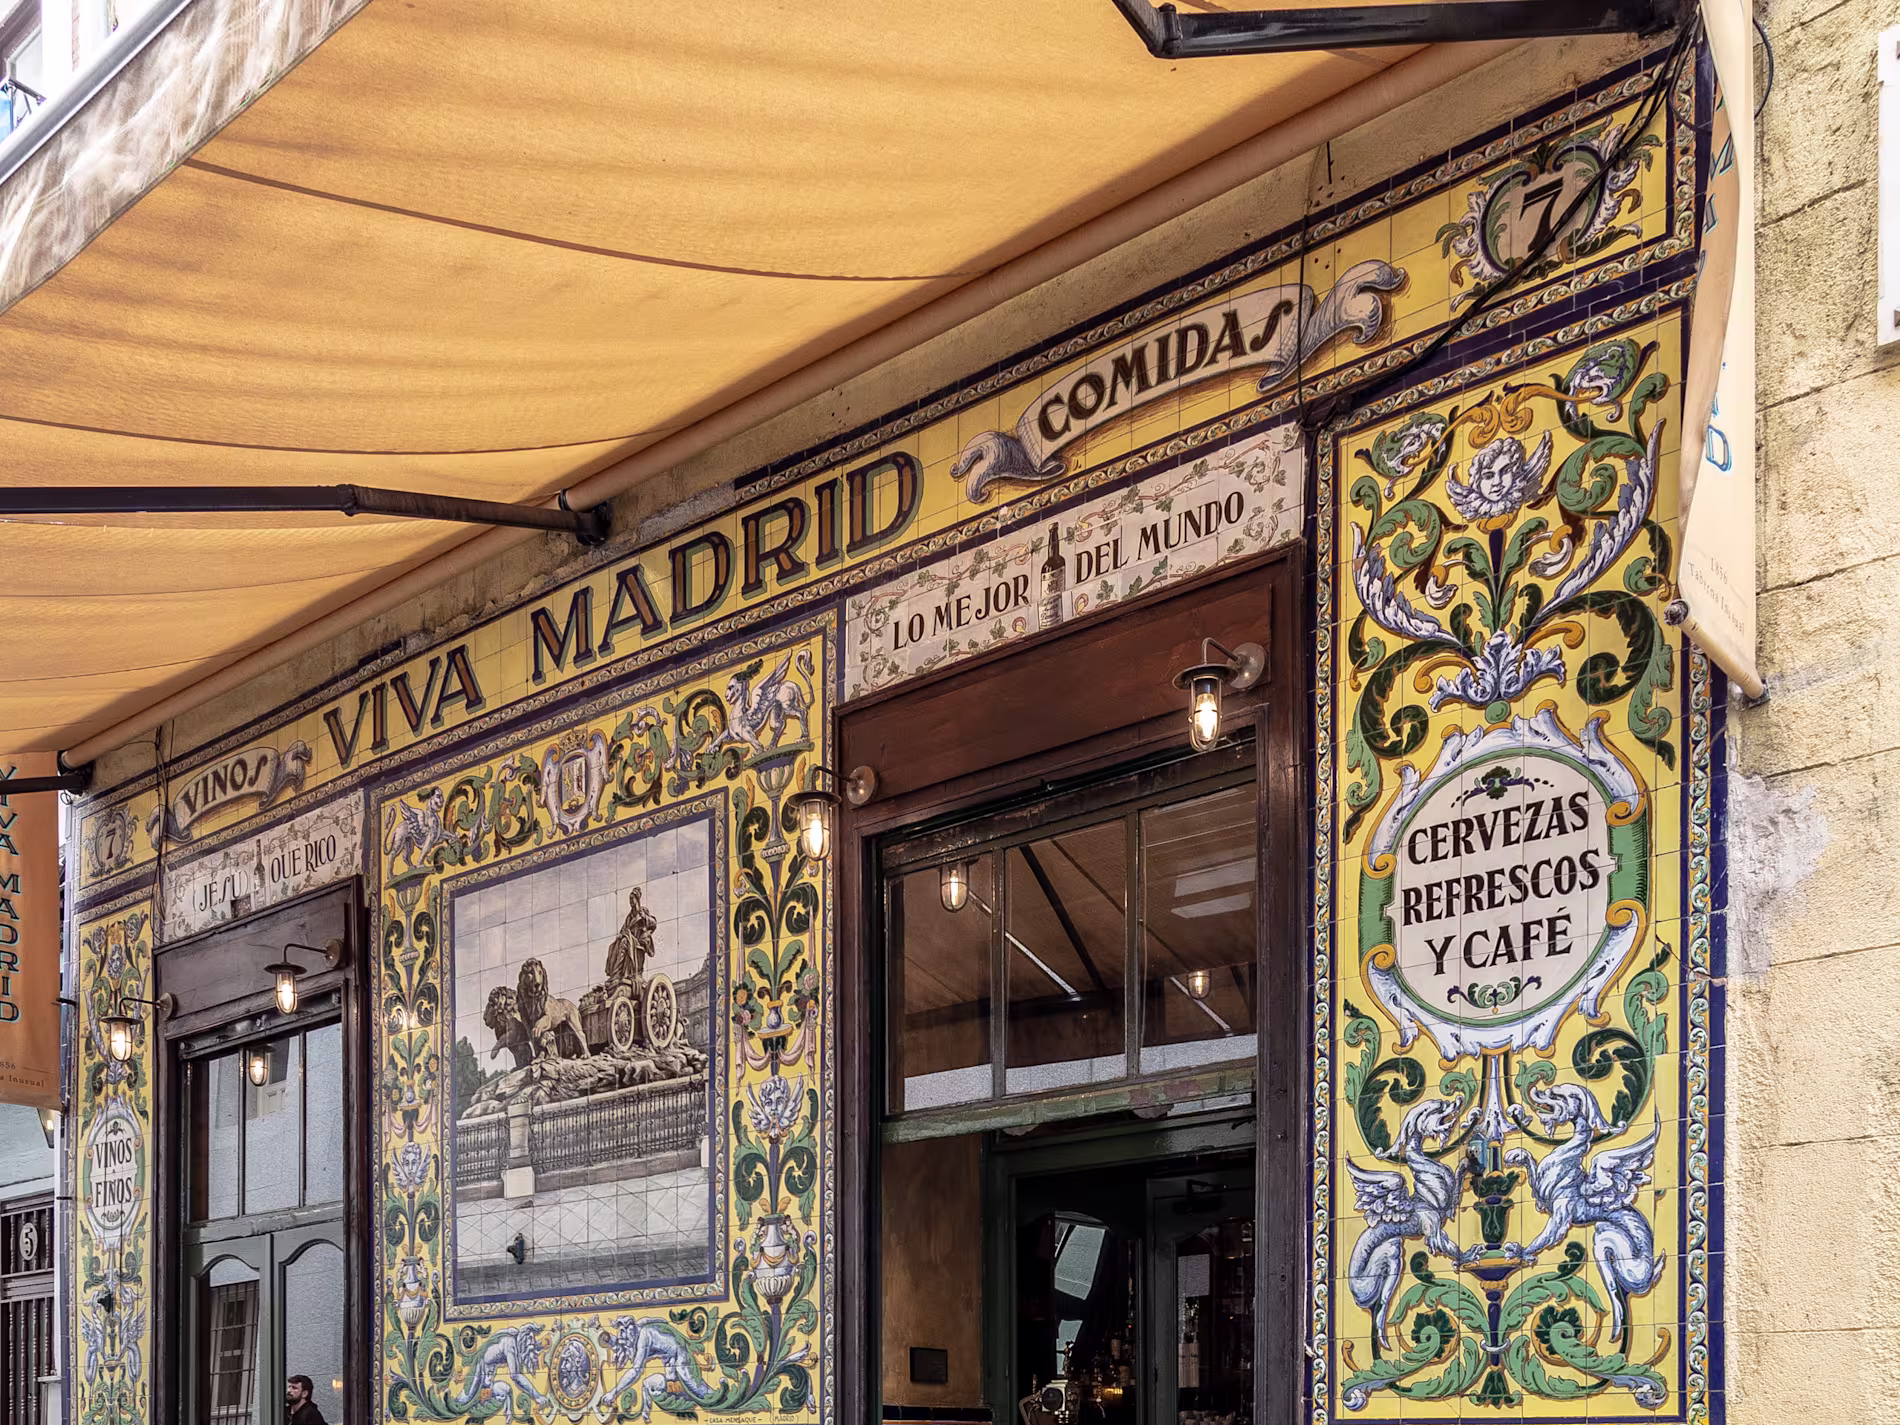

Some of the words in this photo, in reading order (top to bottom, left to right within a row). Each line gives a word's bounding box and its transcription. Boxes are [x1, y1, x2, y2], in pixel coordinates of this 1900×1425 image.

[1517, 176, 1565, 253] 7
[1037, 299, 1294, 442] COMIDAS
[893, 613, 925, 651] LO
[932, 574, 1032, 637] MEJOR
[1075, 538, 1130, 584] DEL
[1136, 491, 1244, 562] MUNDO
[323, 645, 486, 769] VIVA
[530, 450, 924, 685] MADRID
[179, 754, 268, 818] VINOS
[105, 827, 117, 860] 7
[304, 834, 337, 873] RICO
[1406, 790, 1590, 865] CERVEZAS
[1400, 848, 1601, 926] REFRESCOS
[1424, 933, 1456, 976] Y
[1463, 906, 1573, 969] CAFÉ
[9, 1074, 44, 1087] Inusual
[95, 1138, 133, 1169] VINOS
[24, 1227, 34, 1257] 5
